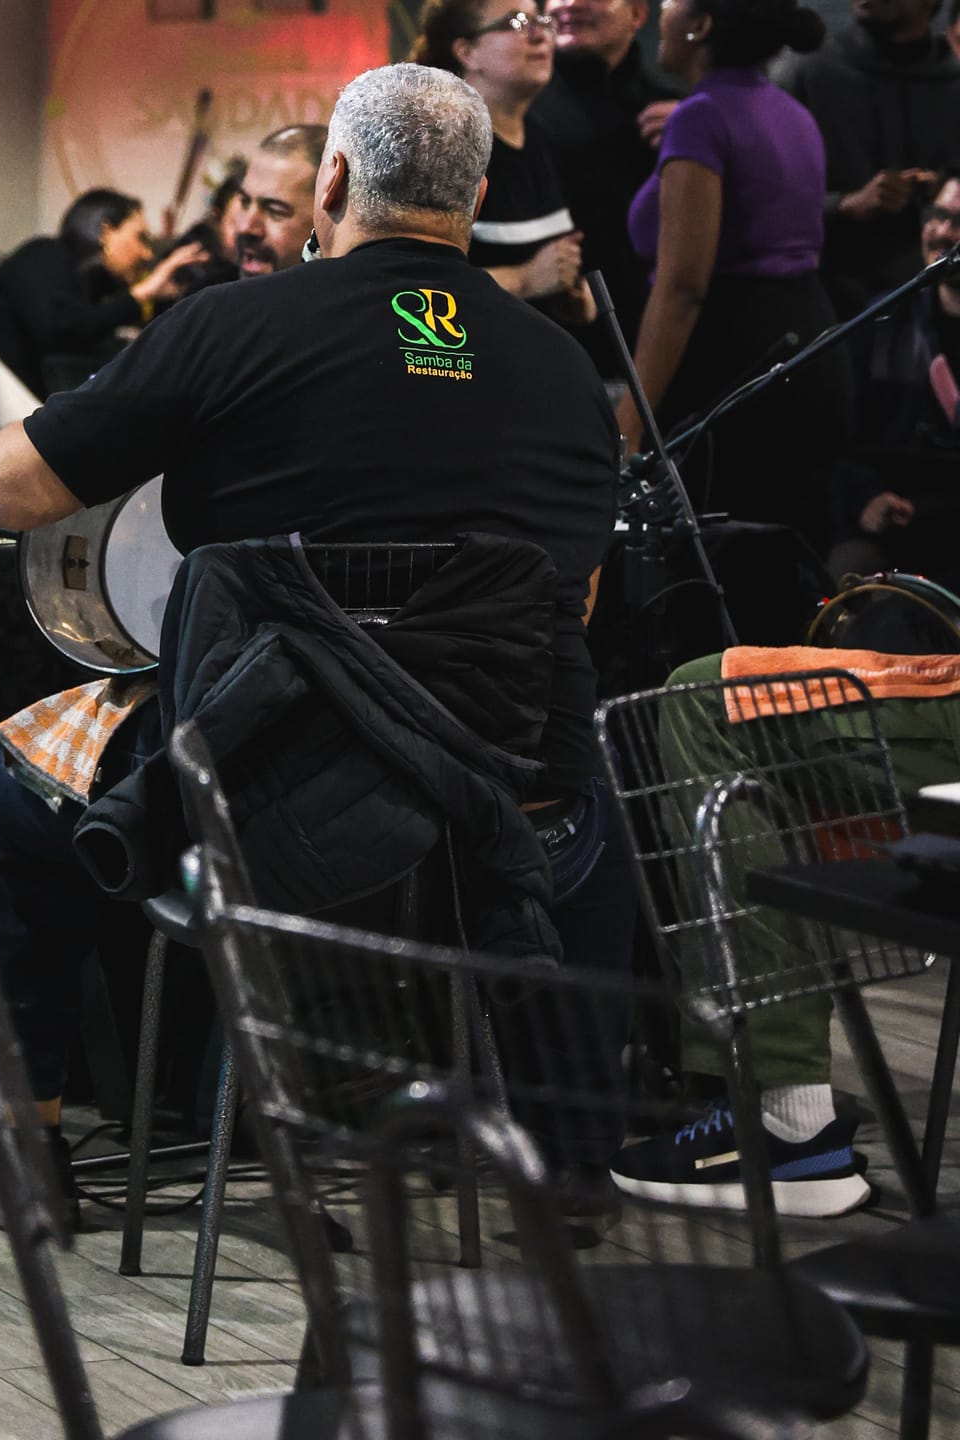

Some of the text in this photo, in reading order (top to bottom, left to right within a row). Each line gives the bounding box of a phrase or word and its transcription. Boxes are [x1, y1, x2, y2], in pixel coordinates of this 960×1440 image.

[404, 352, 472, 371] Samba da
[407, 365, 473, 380] Restauração
